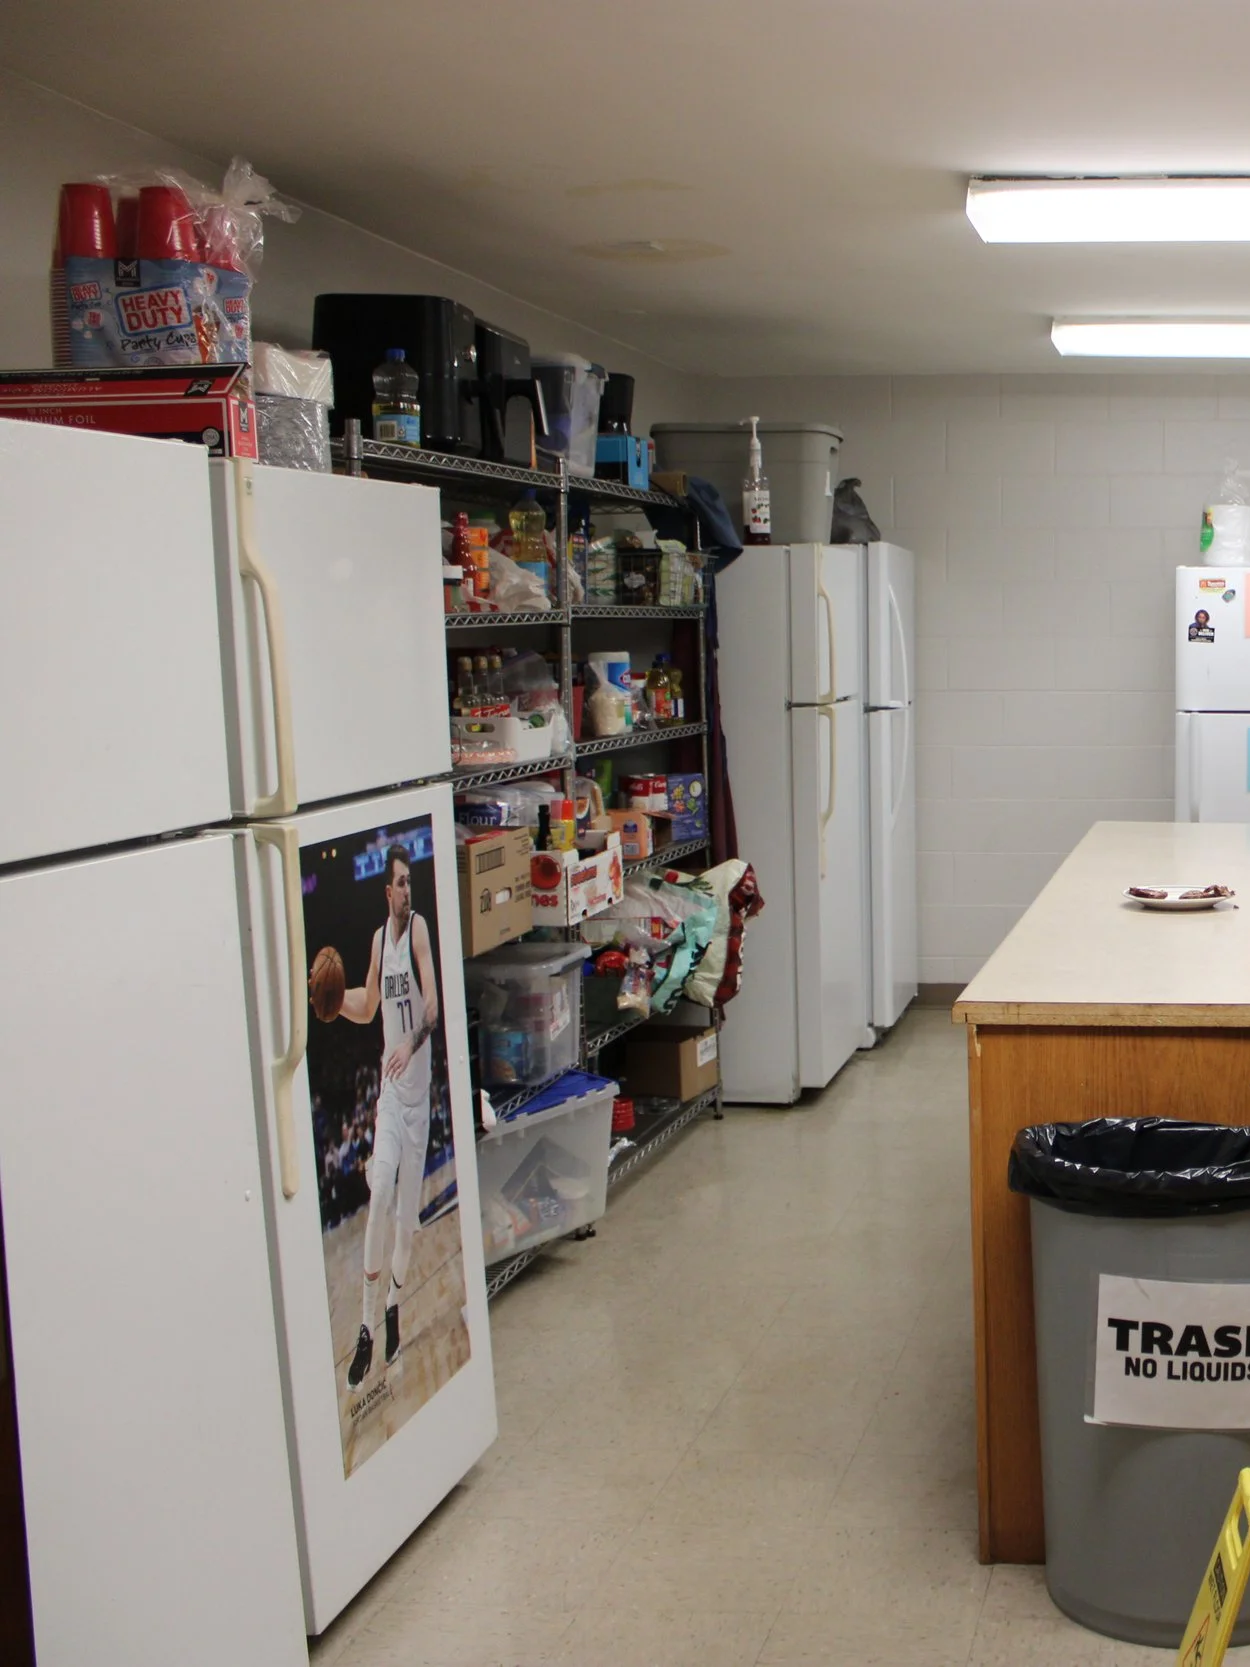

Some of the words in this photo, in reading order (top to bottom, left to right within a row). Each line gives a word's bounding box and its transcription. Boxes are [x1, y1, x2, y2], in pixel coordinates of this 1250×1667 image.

[121, 289, 181, 314] HEAVY
[126, 306, 183, 332] DUTY
[120, 337, 162, 351] Party
[166, 331, 196, 348] Cups
[39, 407, 62, 415] INCH
[68, 415, 96, 425] FOIL
[459, 811, 497, 826] Flour
[384, 971, 410, 999] DALLAS
[396, 998, 414, 1034] 77
[1124, 1356, 1157, 1378] NO
[350, 1397, 367, 1418] LUKA
